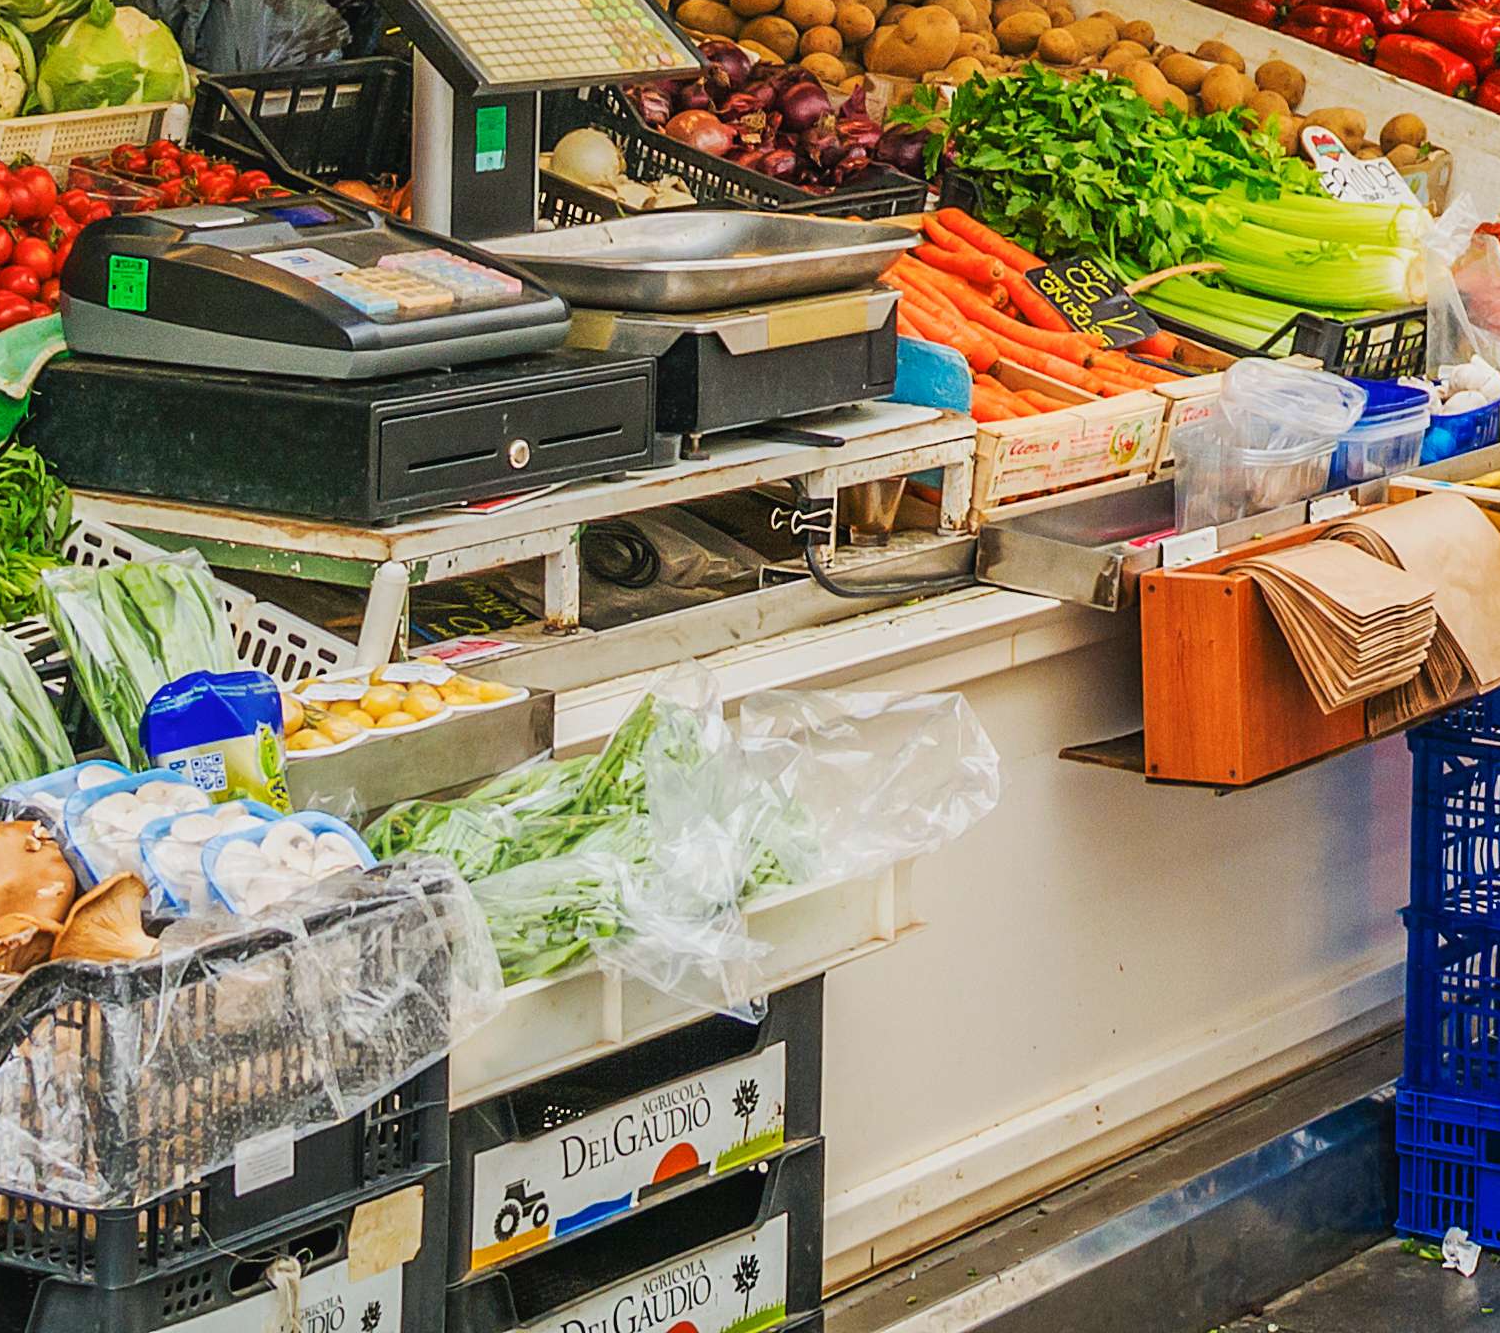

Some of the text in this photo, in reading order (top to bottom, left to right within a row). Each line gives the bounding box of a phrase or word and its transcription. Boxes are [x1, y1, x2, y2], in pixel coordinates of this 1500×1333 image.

[640, 1081, 707, 1118] AGRICOLA
[560, 1098, 713, 1180] DELGAUDIO
[640, 1257, 707, 1299] AGRICOLA
[299, 1292, 345, 1320] GRICOLA
